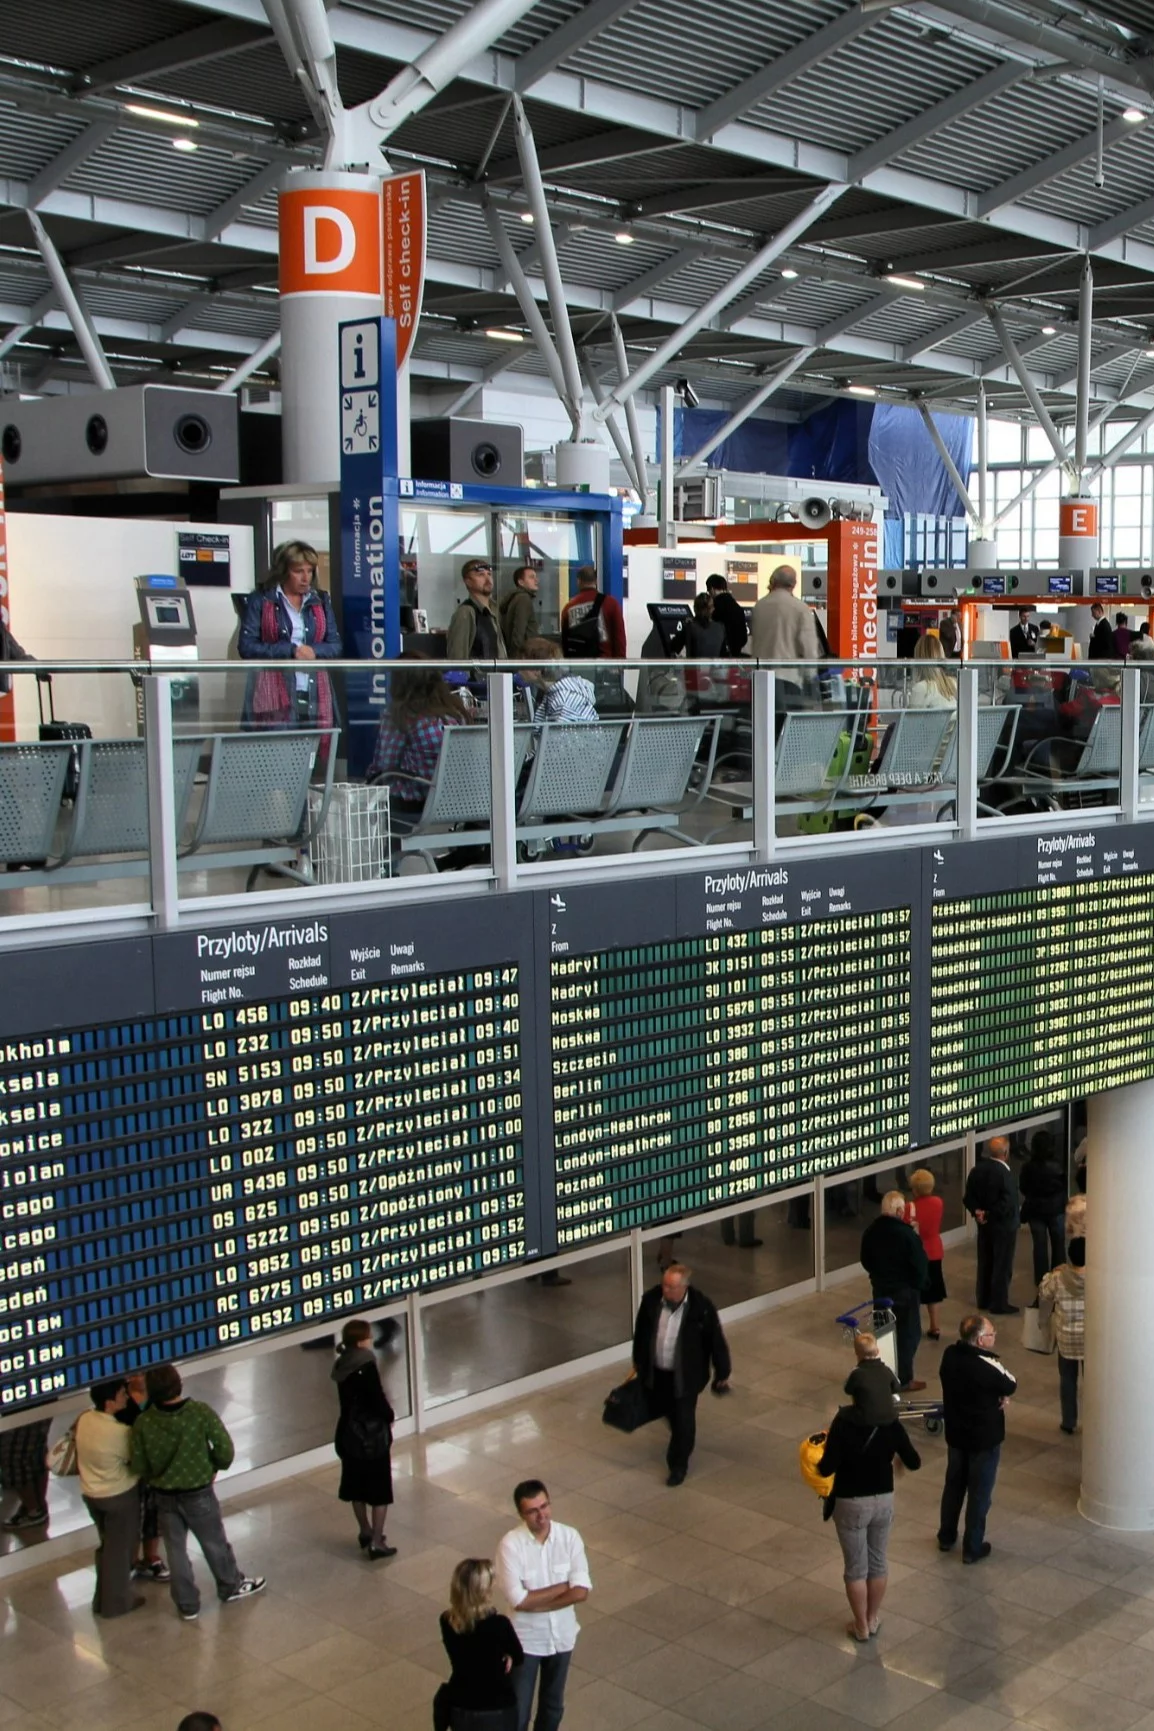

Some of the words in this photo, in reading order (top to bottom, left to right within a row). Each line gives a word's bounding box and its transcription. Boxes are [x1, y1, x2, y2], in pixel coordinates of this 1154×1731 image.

[399, 180, 411, 277] check-in
[303, 206, 356, 275] D
[400, 286, 411, 328] Self
[416, 480, 447, 490] Informacja
[416, 490, 449, 498] Information
[1072, 509, 1087, 531] E
[353, 515, 361, 578] Informacja
[366, 495, 386, 705] Inormation
[1037, 832, 1096, 855] Przyloty/Arrivals
[705, 867, 789, 896] Przyloty/Arrivals
[829, 886, 845, 898] Uwagi
[762, 893, 784, 906] Rozkład
[801, 888, 822, 901] Wyjście
[706, 902, 726, 913] Numer
[727, 900, 742, 912] rejsu
[762, 910, 788, 922] Schedule
[801, 906, 811, 916] Exit
[829, 901, 851, 913] Remarks
[706, 919, 723, 932] Flight
[723, 917, 733, 929] No.
[197, 921, 328, 958] Przyloty/Arrivals
[390, 942, 415, 957] Uwagi
[551, 941, 569, 953] From
[288, 954, 322, 970] Rozkład
[350, 946, 381, 962] Wyjście
[201, 969, 231, 982] Numer
[233, 965, 256, 980] rejsu
[351, 969, 366, 981] Exit
[391, 960, 425, 976] Remarks
[551, 956, 598, 976] Madryt
[289, 974, 328, 990] Schedule
[551, 980, 598, 1001] Madryt
[201, 987, 227, 1004] Flight
[228, 986, 244, 1000] No.
[202, 1012, 224, 1031] LO
[236, 1005, 268, 1025] 456
[289, 995, 341, 1017] 09:40
[474, 968, 518, 988] 09:47
[204, 1041, 226, 1060] LO
[237, 1034, 269, 1054] 232
[291, 1022, 342, 1045] 09:50
[475, 993, 519, 1014] 09:40
[552, 1007, 600, 1025] Moskwa
[552, 1031, 600, 1050] Moskwa
[205, 1070, 227, 1088] SN
[238, 1060, 281, 1083] 5153
[292, 1049, 343, 1073] 09:50
[553, 1051, 616, 1075] Szczecin
[206, 1098, 228, 1117] LO
[240, 1088, 282, 1111] 3878
[293, 1076, 344, 1100] 09:50
[476, 1044, 518, 1065] 09:51
[553, 1079, 601, 1099] Berlin
[208, 1127, 230, 1145] LO
[240, 1118, 273, 1139] 322
[294, 1103, 345, 1128] 09:50
[554, 1103, 602, 1124] Berlin
[210, 1155, 231, 1174] LO
[242, 1146, 274, 1167] 002
[296, 1130, 346, 1155] 09:50
[479, 1093, 521, 1115] 10:00
[555, 1111, 671, 1148] Londyn-Heathrow
[555, 1134, 671, 1172] Londyn-Heathrow
[211, 1183, 233, 1202] UA
[243, 1171, 286, 1195] 9436
[297, 1157, 347, 1182] 09:50
[212, 1211, 234, 1230] OS
[245, 1200, 277, 1222] 625
[298, 1184, 349, 1209] 09:50
[472, 1145, 514, 1168] 11:10
[556, 1172, 604, 1196] Poznań
[214, 1239, 236, 1258] LO
[246, 1225, 289, 1250] 5222
[299, 1210, 350, 1237] 09:50
[473, 1170, 515, 1193] 11:10
[557, 1196, 612, 1220] Hamburg
[215, 1266, 237, 1286] LO
[248, 1252, 290, 1277] 3852
[301, 1237, 351, 1263] 09:50
[481, 1192, 524, 1216] 09:52
[557, 1219, 613, 1244] Hamburg
[217, 1294, 238, 1314] AC
[249, 1279, 291, 1305] 6775
[302, 1263, 352, 1290] 09:50
[218, 1321, 240, 1341] OS
[250, 1306, 292, 1332] 8532
[303, 1289, 353, 1317] 09:50
